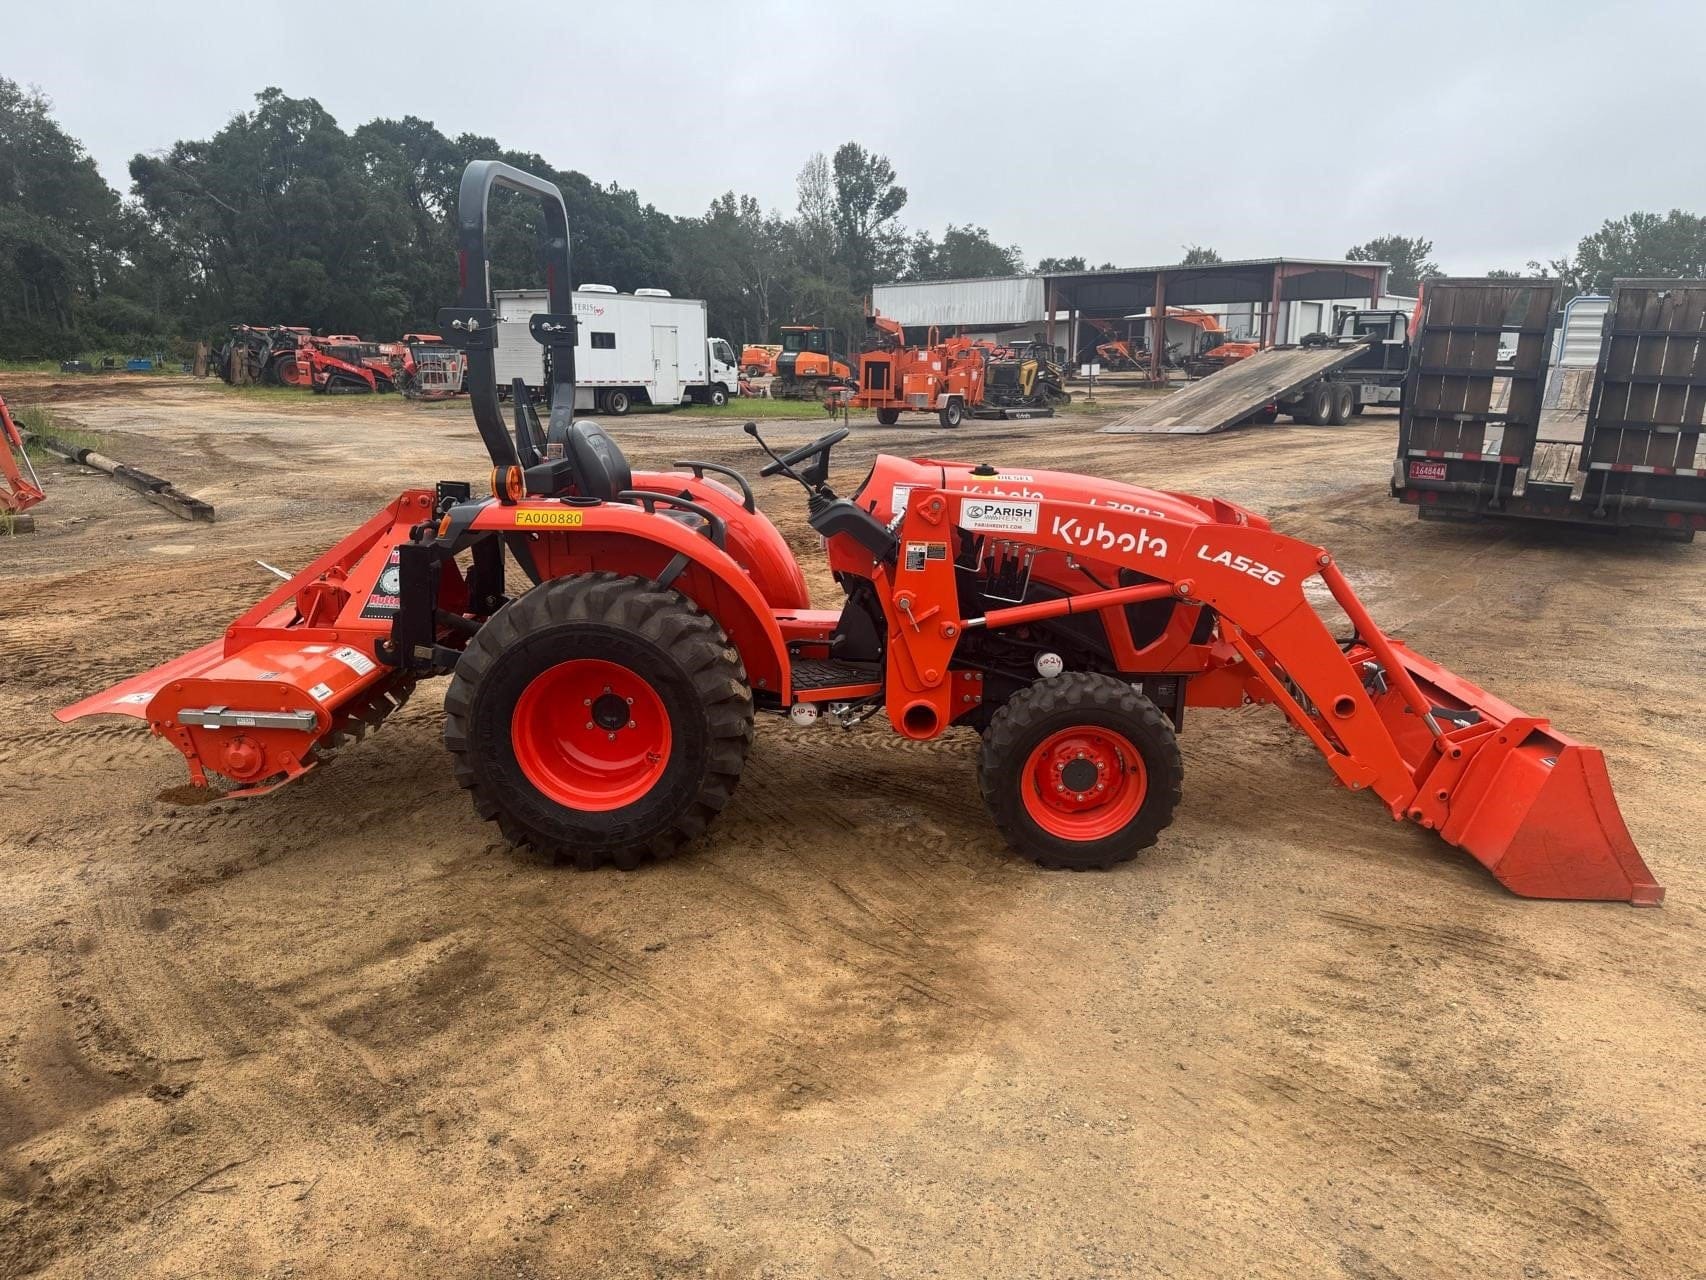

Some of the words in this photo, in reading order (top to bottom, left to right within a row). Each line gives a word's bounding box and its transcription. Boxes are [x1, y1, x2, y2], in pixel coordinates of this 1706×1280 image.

[963, 485, 1044, 500] Kbota
[516, 512, 582, 524] FA000880
[984, 505, 1032, 517] PARISH
[1052, 516, 1168, 558] Kubota
[1197, 544, 1286, 586] LA526
